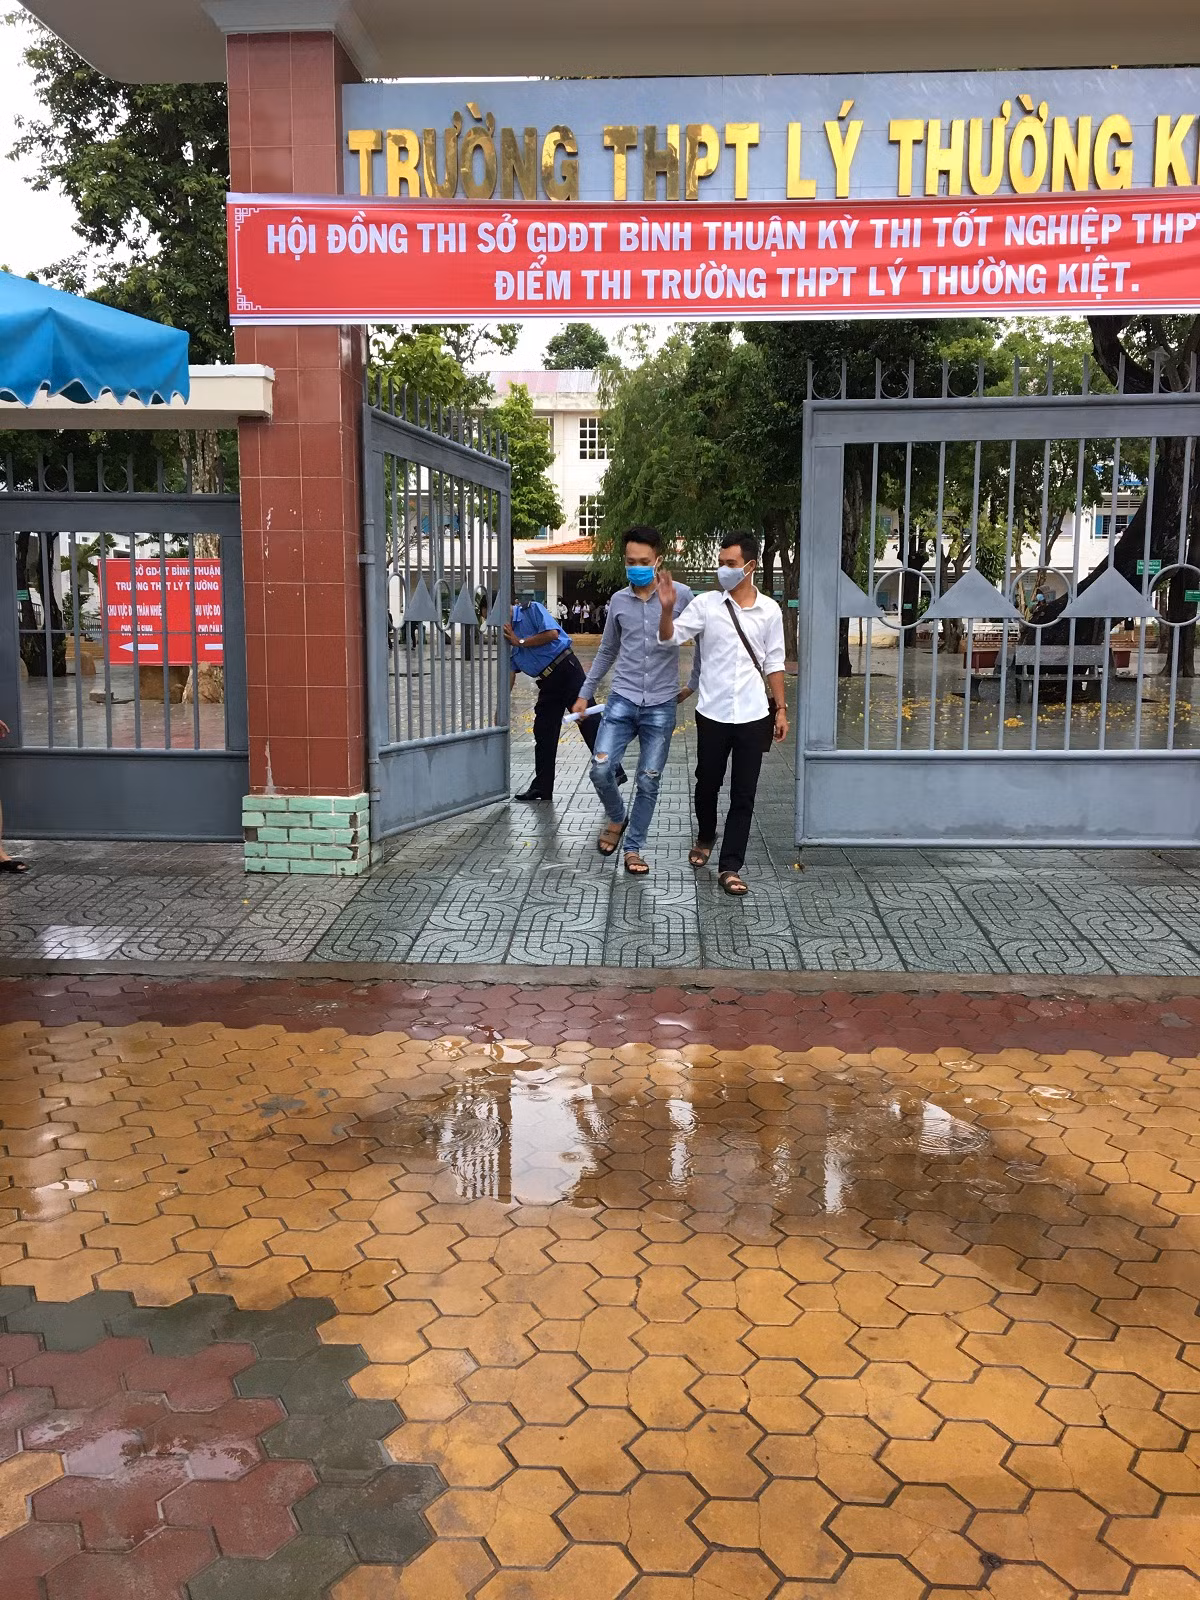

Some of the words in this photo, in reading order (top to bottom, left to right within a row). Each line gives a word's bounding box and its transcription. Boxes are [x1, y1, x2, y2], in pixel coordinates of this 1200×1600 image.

[347, 102, 579, 200] TRƯỜNG
[603, 123, 760, 200] THPT
[786, 99, 864, 199] LÝ
[889, 94, 1133, 197] THƯỜNG
[1152, 113, 1200, 188] K
[266, 216, 317, 260] HỘI
[326, 210, 408, 254] ĐỒNG
[417, 222, 467, 253] THI
[476, 212, 517, 253] SỞ
[527, 221, 608, 253] GDĐT
[619, 216, 692, 252] BÌNH
[703, 215, 806, 257] THUẬN
[818, 213, 860, 249] KỲ
[869, 218, 921, 249] THI
[932, 208, 993, 248] TỐT
[1005, 206, 1122, 253] NGHIỆP
[1131, 212, 1200, 244] THP
[494, 254, 571, 301] ĐIỂM
[581, 269, 631, 300] THI
[642, 261, 767, 299] TRƯỜNG
[776, 265, 858, 298] THPT
[868, 257, 907, 296] LÝ
[917, 256, 1046, 296] THƯỜNG
[1057, 254, 1140, 300] KIỆT.
[151, 582, 171, 591] THT
[194, 564, 221, 578] THUẬN
